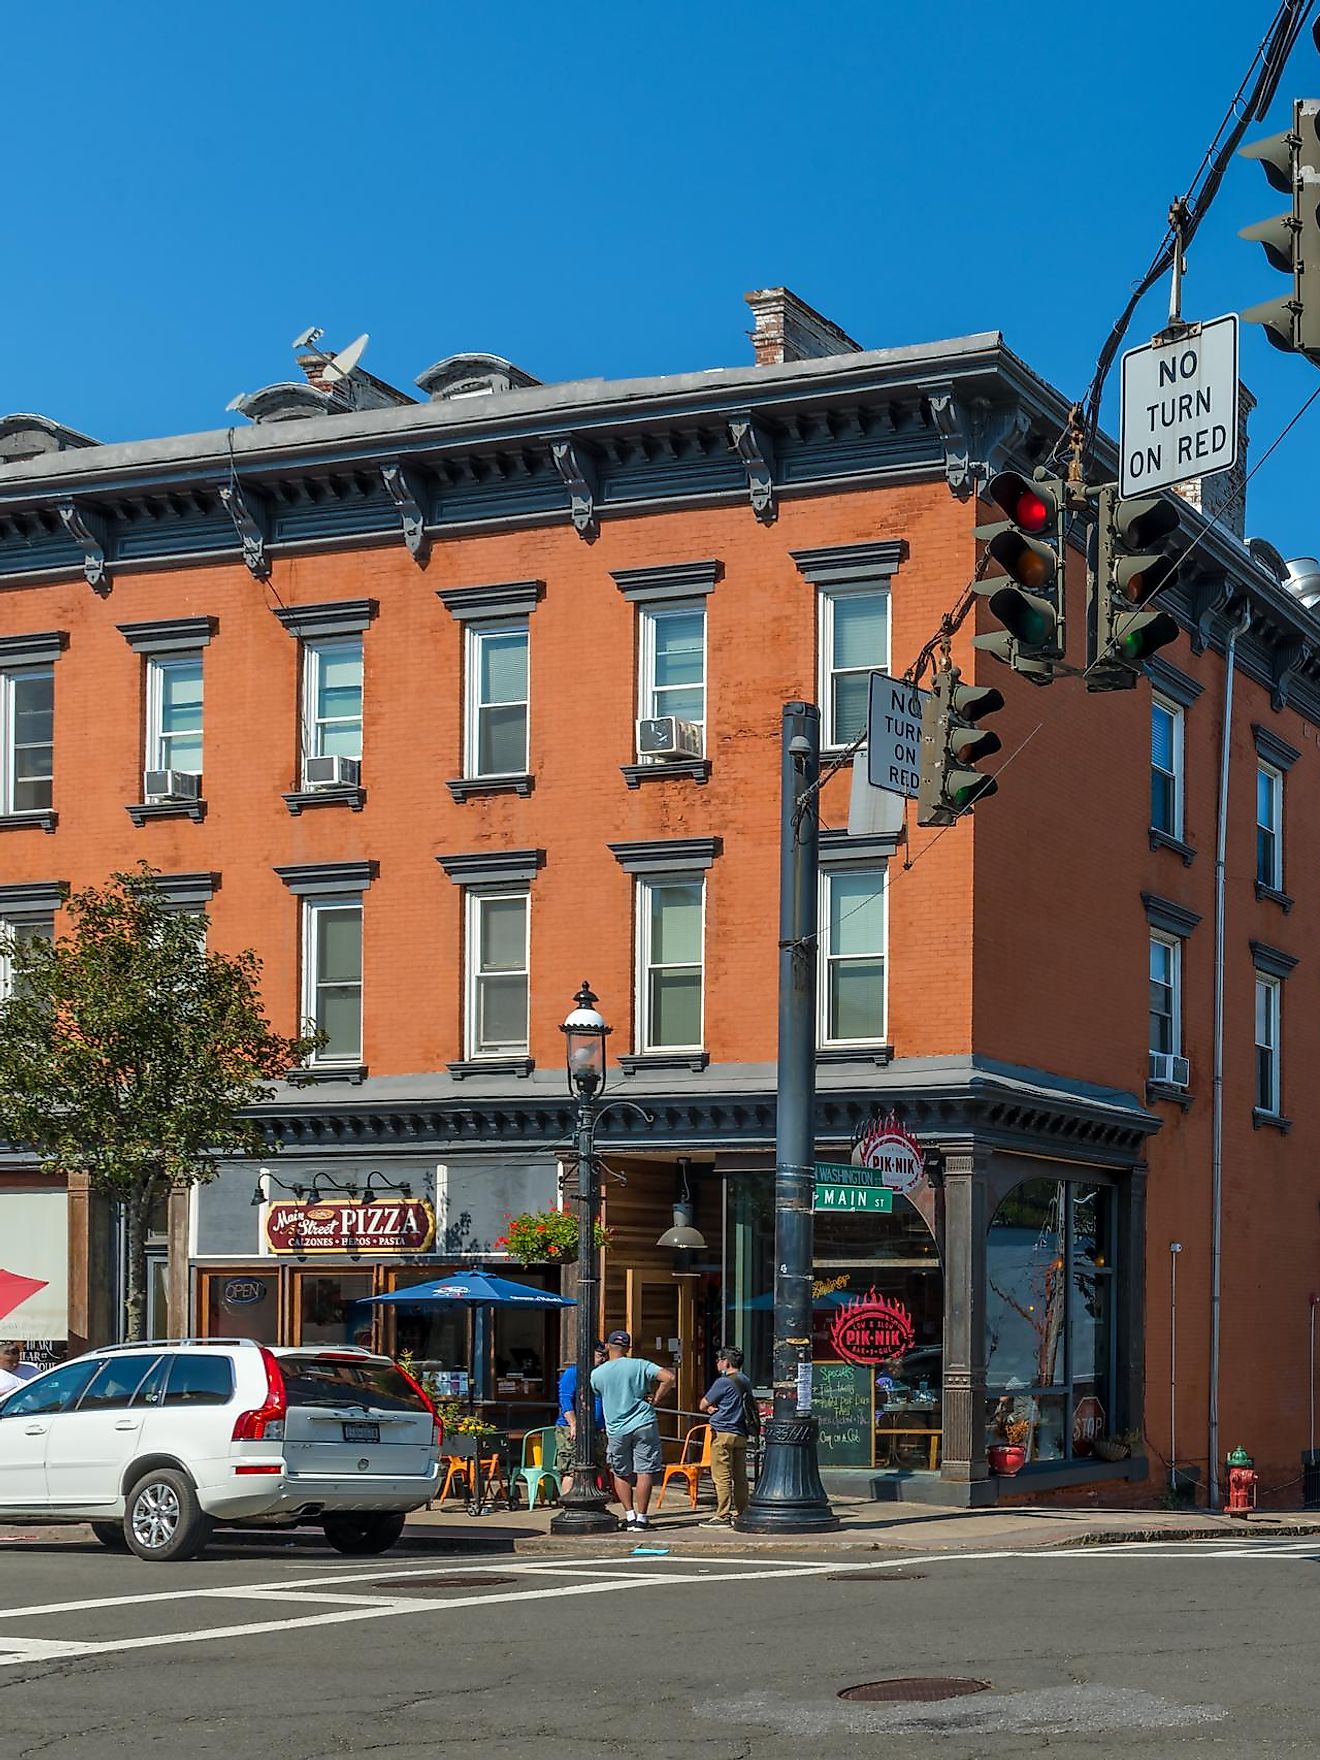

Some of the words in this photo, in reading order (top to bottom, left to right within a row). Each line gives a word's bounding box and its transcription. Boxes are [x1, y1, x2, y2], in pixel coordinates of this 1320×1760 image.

[1159, 350, 1198, 388] NO
[1147, 386, 1211, 432] TURN
[1130, 444, 1162, 479] ON
[1178, 424, 1227, 465] RED
[891, 689, 923, 720] NO
[894, 743, 916, 766] ON
[889, 765, 920, 790] RED
[819, 1166, 873, 1186] WASHINGTON
[824, 1189, 868, 1207] MAIN
[874, 1198, 885, 1208] ST
[272, 1209, 305, 1233] Main
[298, 1218, 340, 1236] Street
[339, 1208, 421, 1235] PIZZA
[288, 1237, 334, 1247] CALZONES
[341, 1237, 371, 1247] HEROS
[379, 1237, 406, 1246] PASTA
[225, 1283, 259, 1299] OPEN
[1073, 1417, 1103, 1441] STOP
